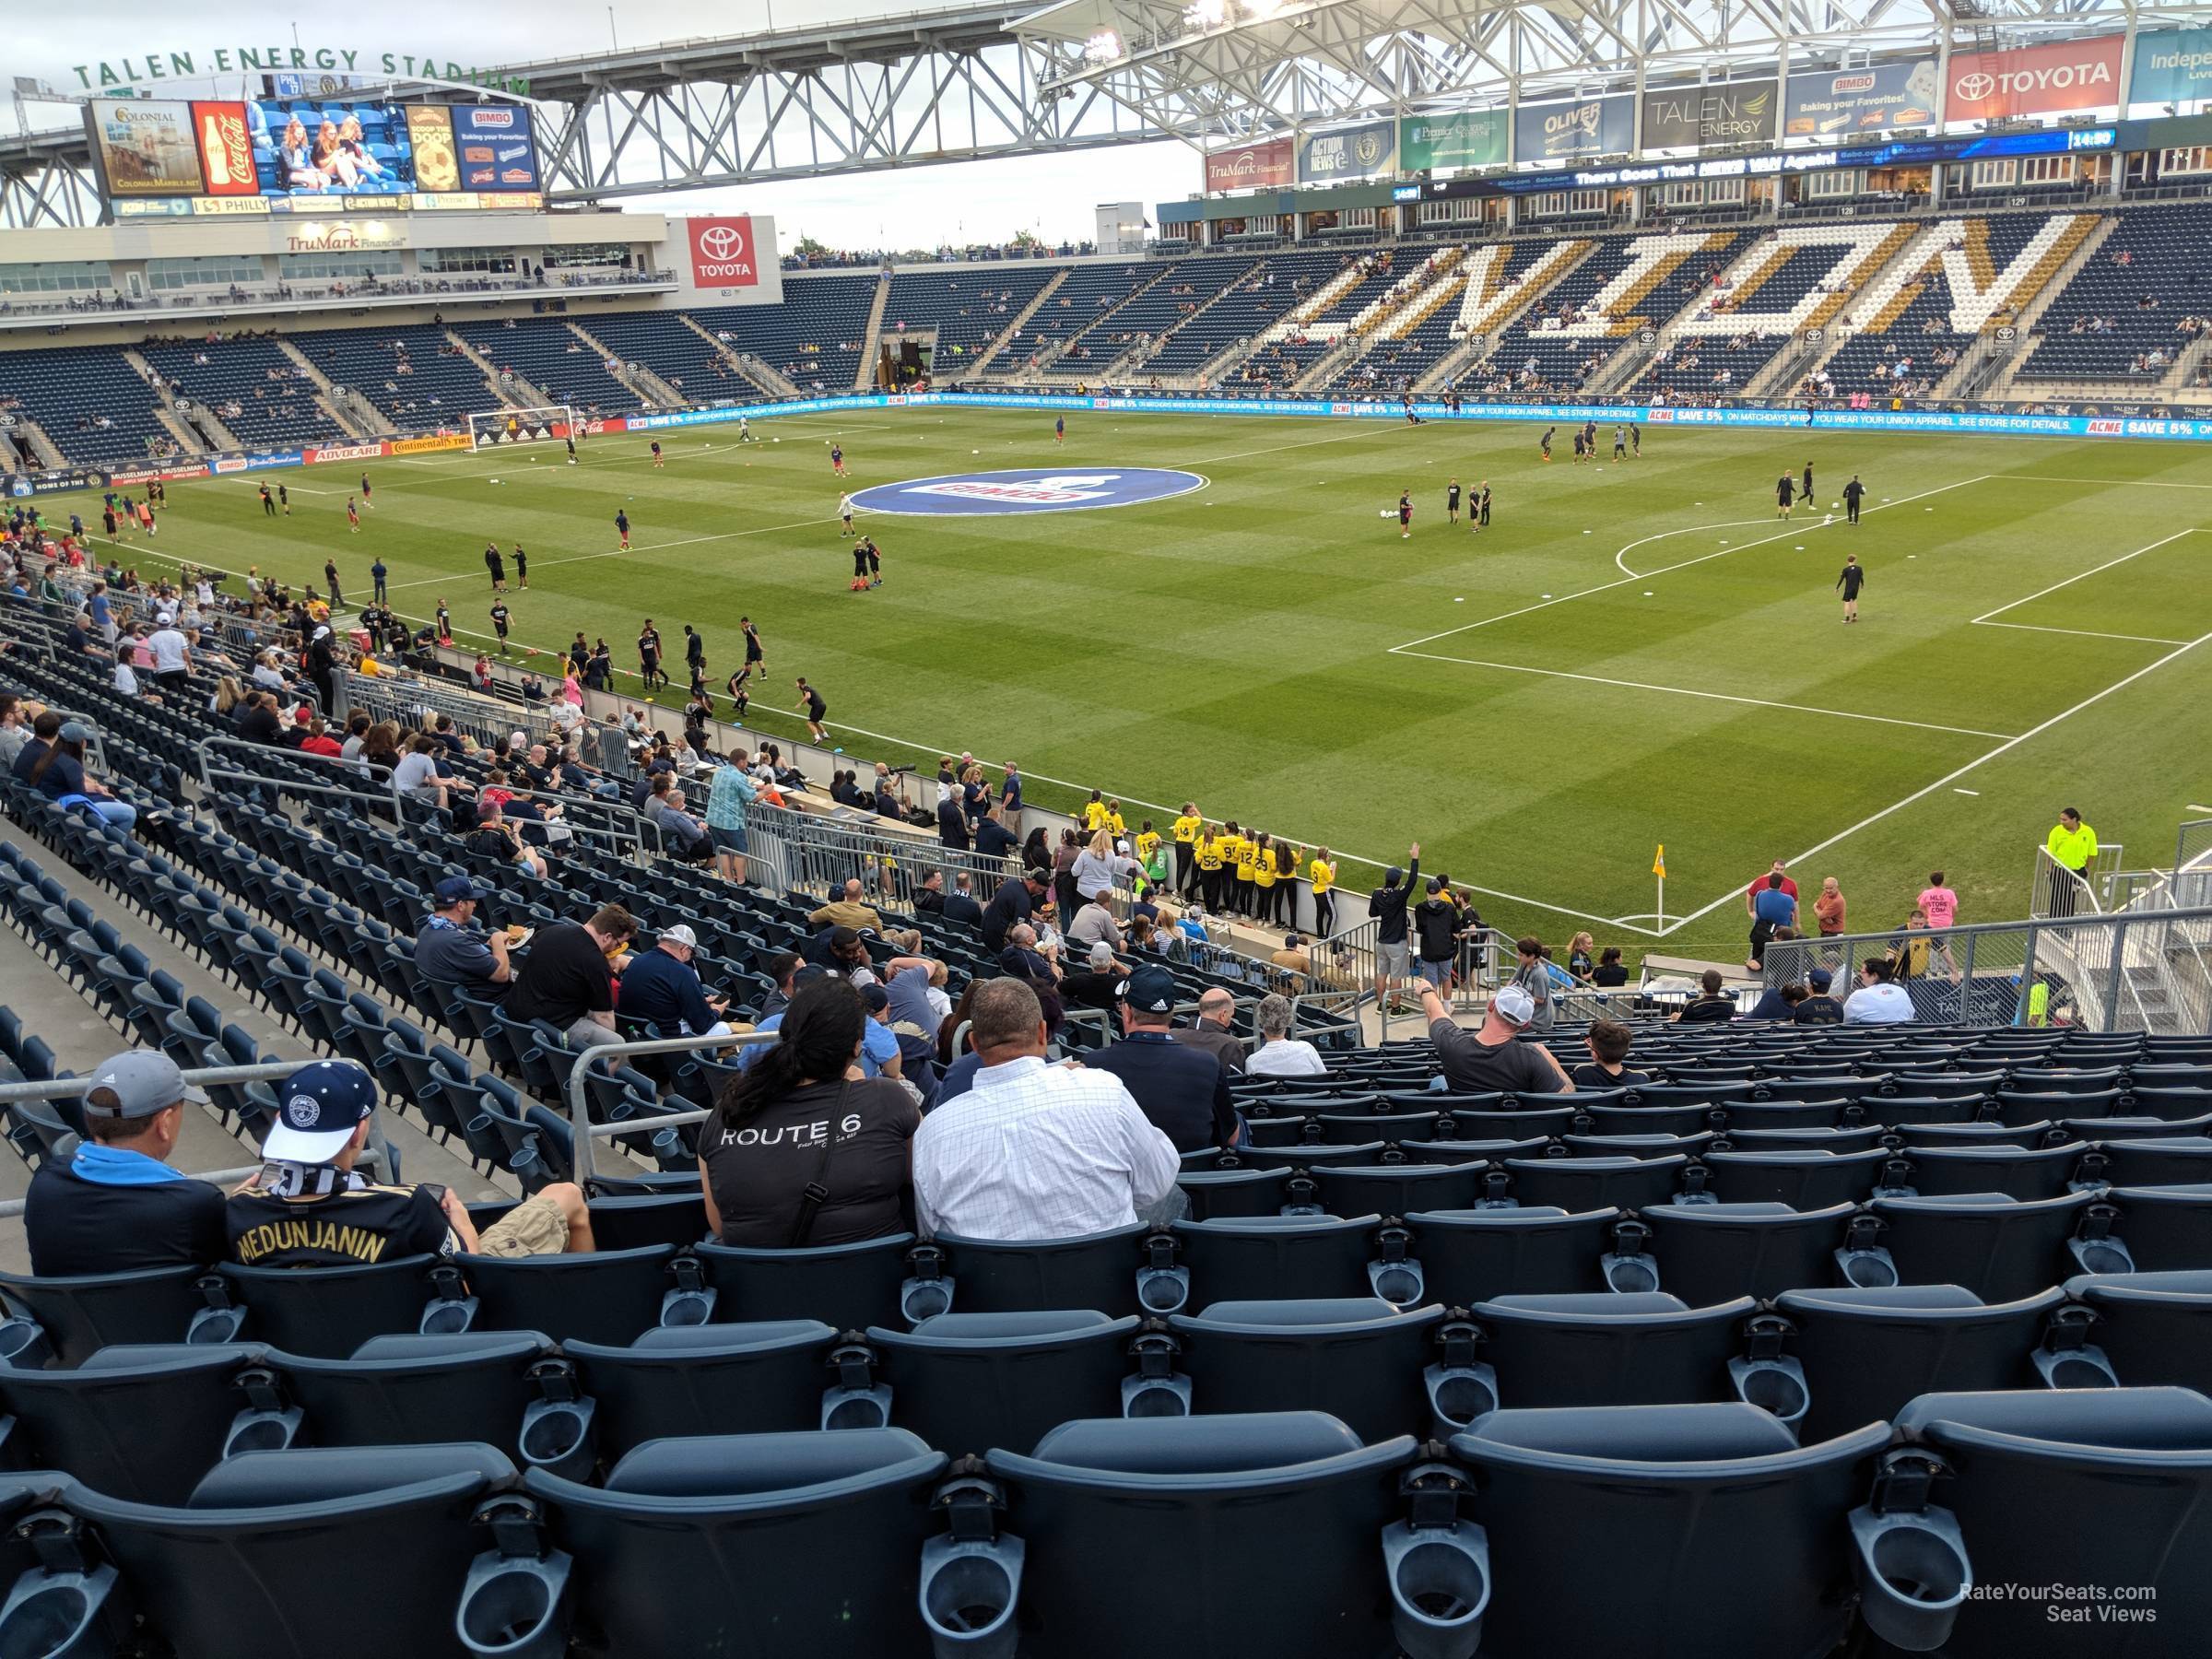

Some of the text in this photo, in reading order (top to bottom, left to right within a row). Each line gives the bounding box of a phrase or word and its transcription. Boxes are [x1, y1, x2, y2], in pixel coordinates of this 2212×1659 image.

[73, 47, 531, 97] TALEN ENERGY STADIUM
[1998, 62, 2111, 94] TOYOTA
[1835, 76, 1873, 89] BIMBO
[1651, 95, 1737, 125] TALEN
[1800, 93, 1905, 112] Baking your Favorites!
[476, 112, 511, 124] BIMBO
[1545, 102, 1601, 134] OLIVER
[1700, 118, 1762, 137] ENERGY
[413, 133, 452, 144] DOOP
[1311, 135, 1344, 157] ACTION
[219, 112, 253, 184] Coca-Cola
[1210, 156, 1255, 178] TruMark
[1311, 154, 1335, 172] NEWS
[1662, 164, 1696, 178] That
[1784, 152, 1837, 170] Again!
[225, 200, 267, 211] PHILLY
[2011, 197, 2026, 206] 129
[1841, 206, 1854, 216] 128
[1674, 217, 1686, 225] 127
[288, 230, 403, 251] TruMark Financial
[699, 263, 751, 277] TOYOTA
[1263, 213, 2102, 340] UNION
[1333, 405, 1350, 413] ACME
[1353, 405, 1373, 414] SAVE
[1374, 405, 1387, 414] 5%
[1649, 411, 1673, 420] ACME
[1677, 410, 1703, 421] SAVE
[1706, 410, 1723, 421] 5%
[1727, 413, 1738, 421] ON
[1741, 413, 1788, 422] MATCHDAYS
[1816, 415, 1833, 423] YOU
[1834, 416, 1858, 424] WEAR
[1886, 417, 1914, 425] UNION
[1978, 419, 2008, 428] STORE
[2010, 419, 2029, 429] FOR
[2088, 422, 2121, 432] ACME
[2128, 422, 2165, 434] SAVE
[2170, 423, 2194, 435] 5%
[394, 437, 473, 453] Continental TIRE
[315, 446, 381, 462] ADVOCARE
[161, 464, 209, 476] MUSSELMAN'S
[218, 461, 246, 470] BIMBO
[111, 469, 159, 480] MUSSELMAN'S
[935, 484, 1079, 501] BIMBO
[1203, 855, 1218, 866] 52
[1241, 853, 1253, 864] 12
[1255, 858, 1268, 871] 29
[721, 1120, 830, 1146] ROUTE
[841, 1113, 862, 1133] 6
[237, 1220, 387, 1265] MEDUNJANIN
